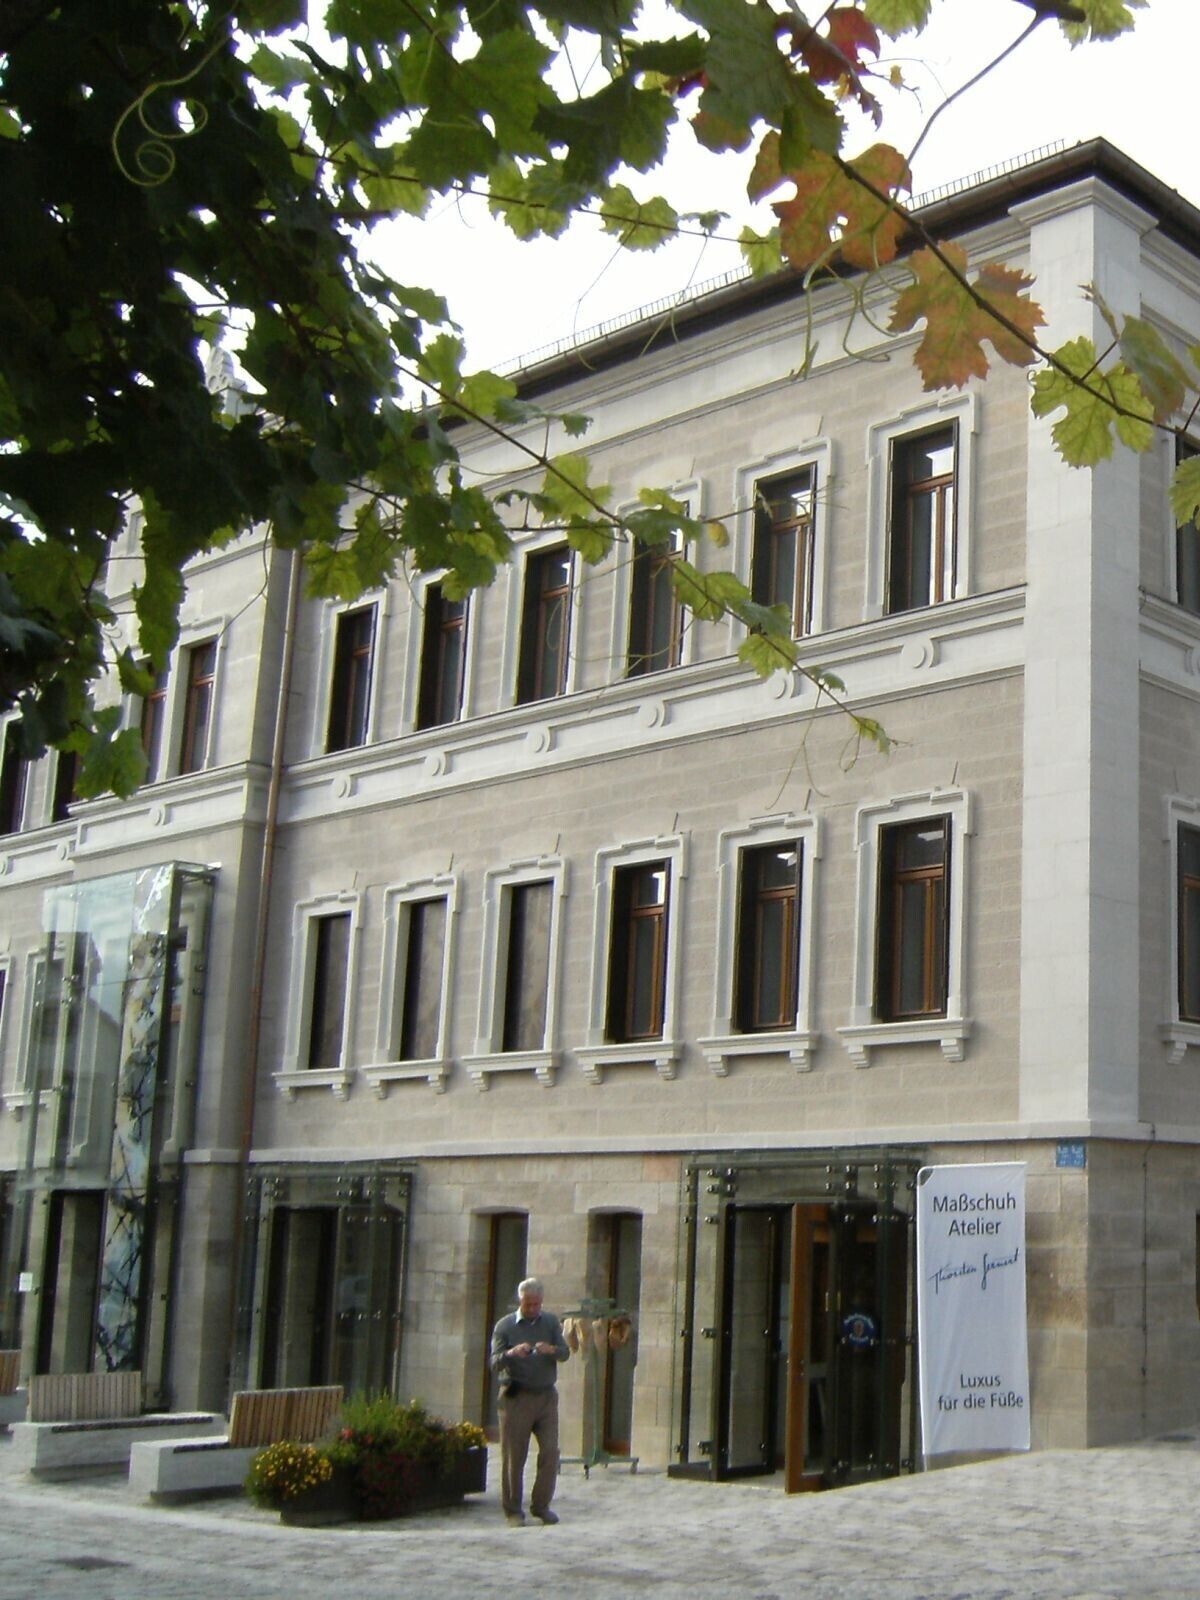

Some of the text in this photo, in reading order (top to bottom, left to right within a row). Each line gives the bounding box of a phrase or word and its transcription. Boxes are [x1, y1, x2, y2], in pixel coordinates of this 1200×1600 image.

[932, 1192, 1017, 1213] Maßschuh
[948, 1217, 1001, 1236] Atelier
[960, 1374, 1001, 1389] Luxus
[938, 1391, 1024, 1412] für die Füße
